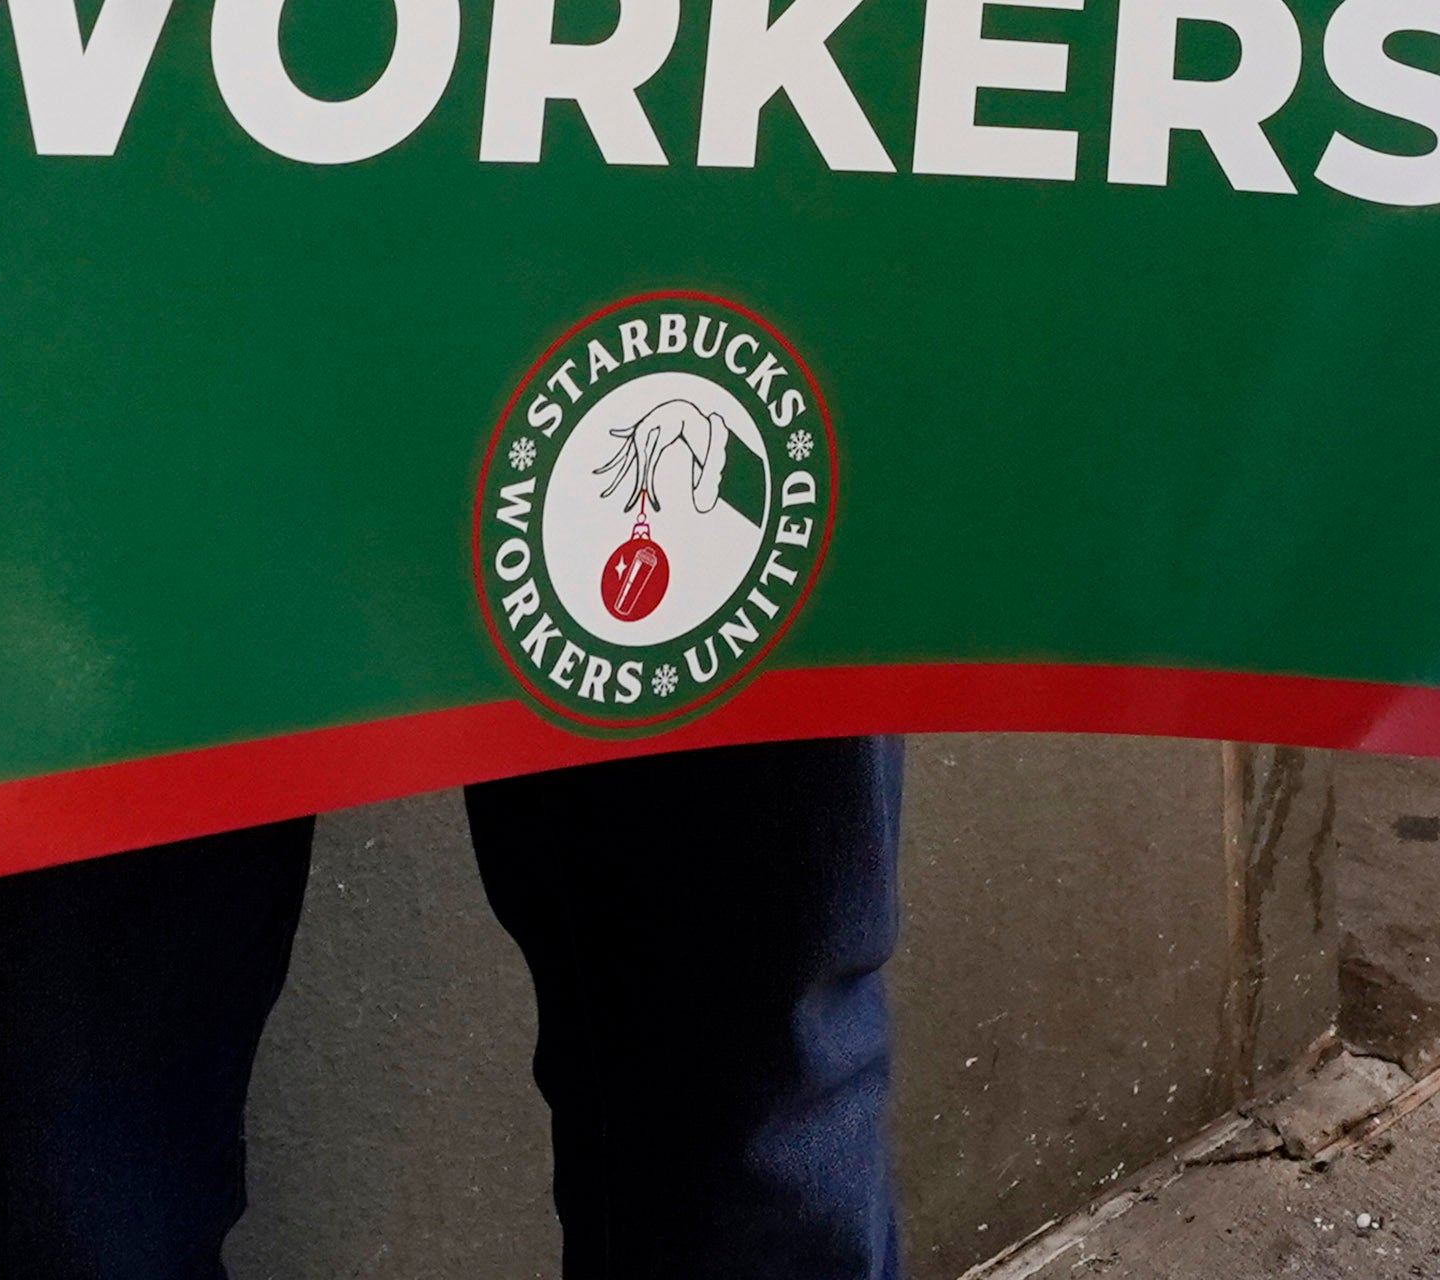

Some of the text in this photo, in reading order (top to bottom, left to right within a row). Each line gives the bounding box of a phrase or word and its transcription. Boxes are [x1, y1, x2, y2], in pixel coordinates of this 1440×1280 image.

[526, 313, 807, 439] STARBUCKS
[494, 475, 644, 705] WORKERS
[682, 469, 817, 684] UNITED
